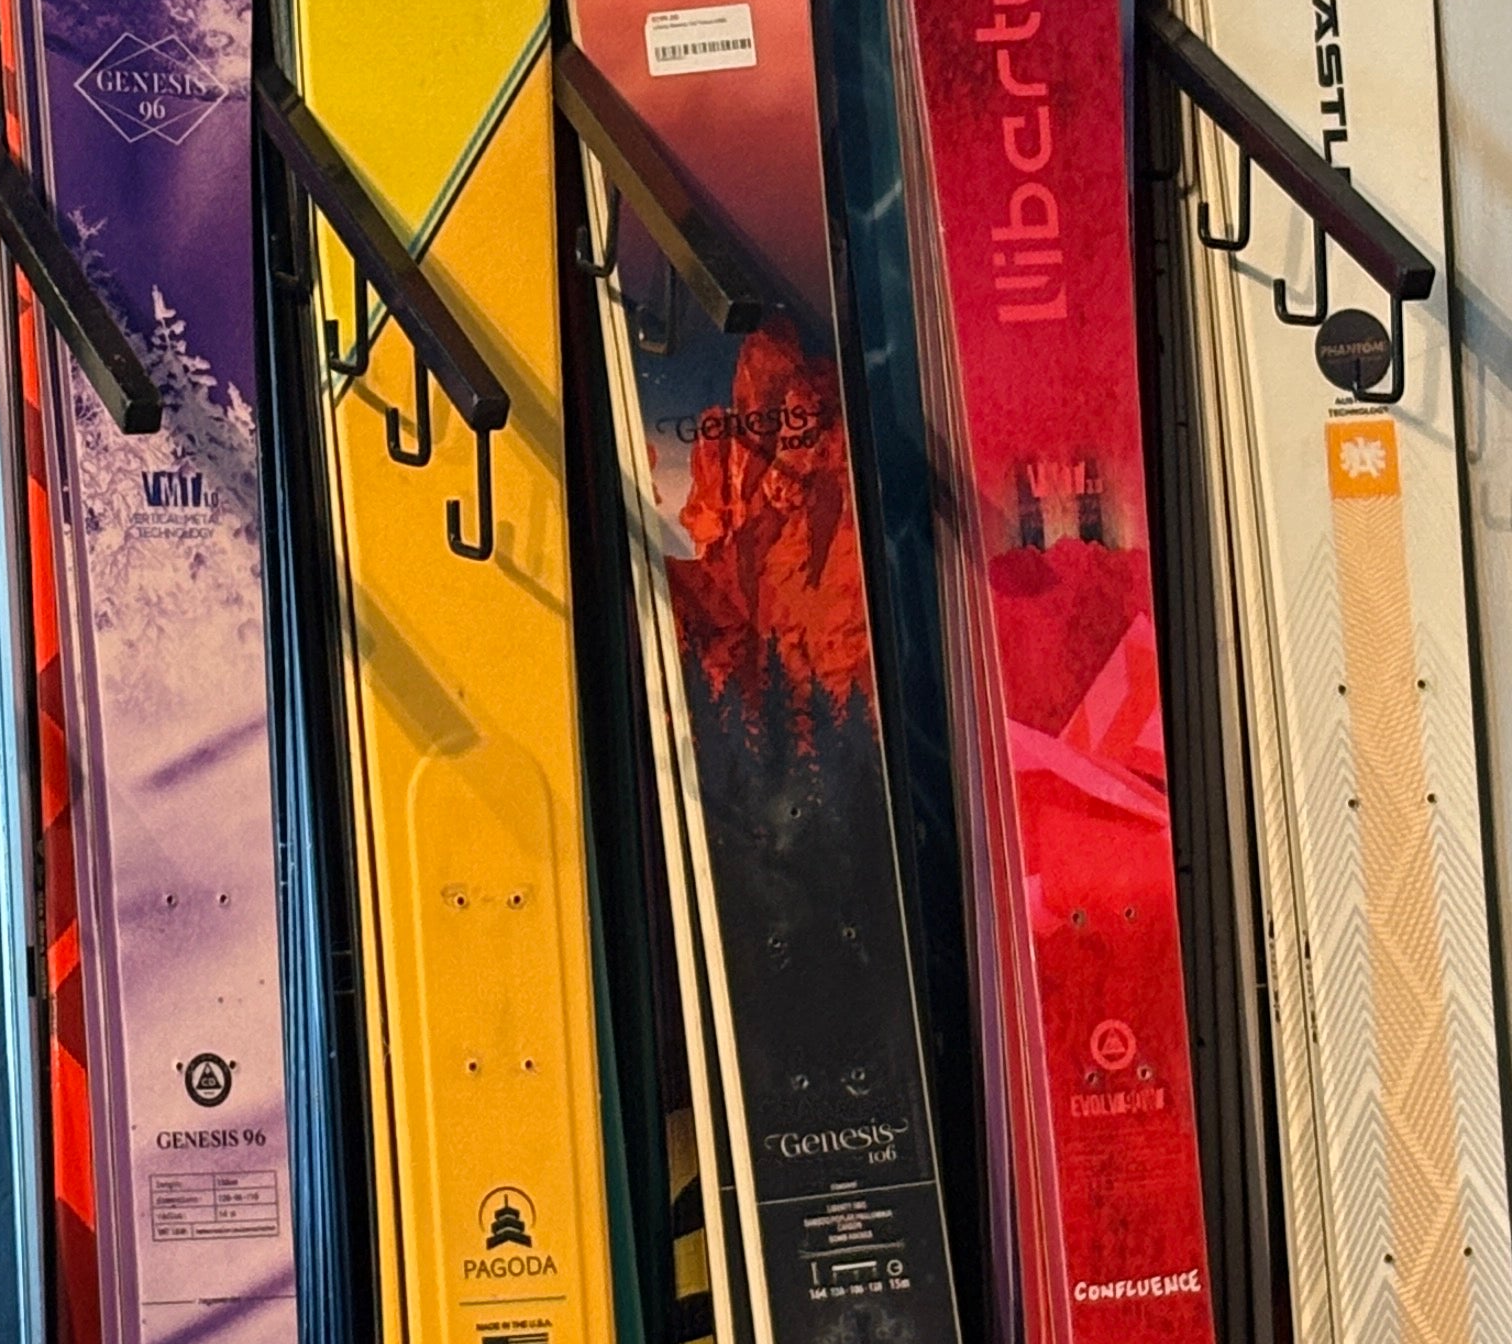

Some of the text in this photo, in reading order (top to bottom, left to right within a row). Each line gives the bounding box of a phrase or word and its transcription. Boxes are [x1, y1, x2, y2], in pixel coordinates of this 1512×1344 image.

[96, 69, 207, 96] GENESIS
[139, 96, 166, 122] 96
[156, 1128, 266, 1150] GENESIS 96
[764, 1117, 909, 1158] Genesis
[868, 1144, 897, 1164] 106
[463, 1255, 558, 1279] PAGODA
[1074, 1269, 1201, 1301] CONFLUENCE
